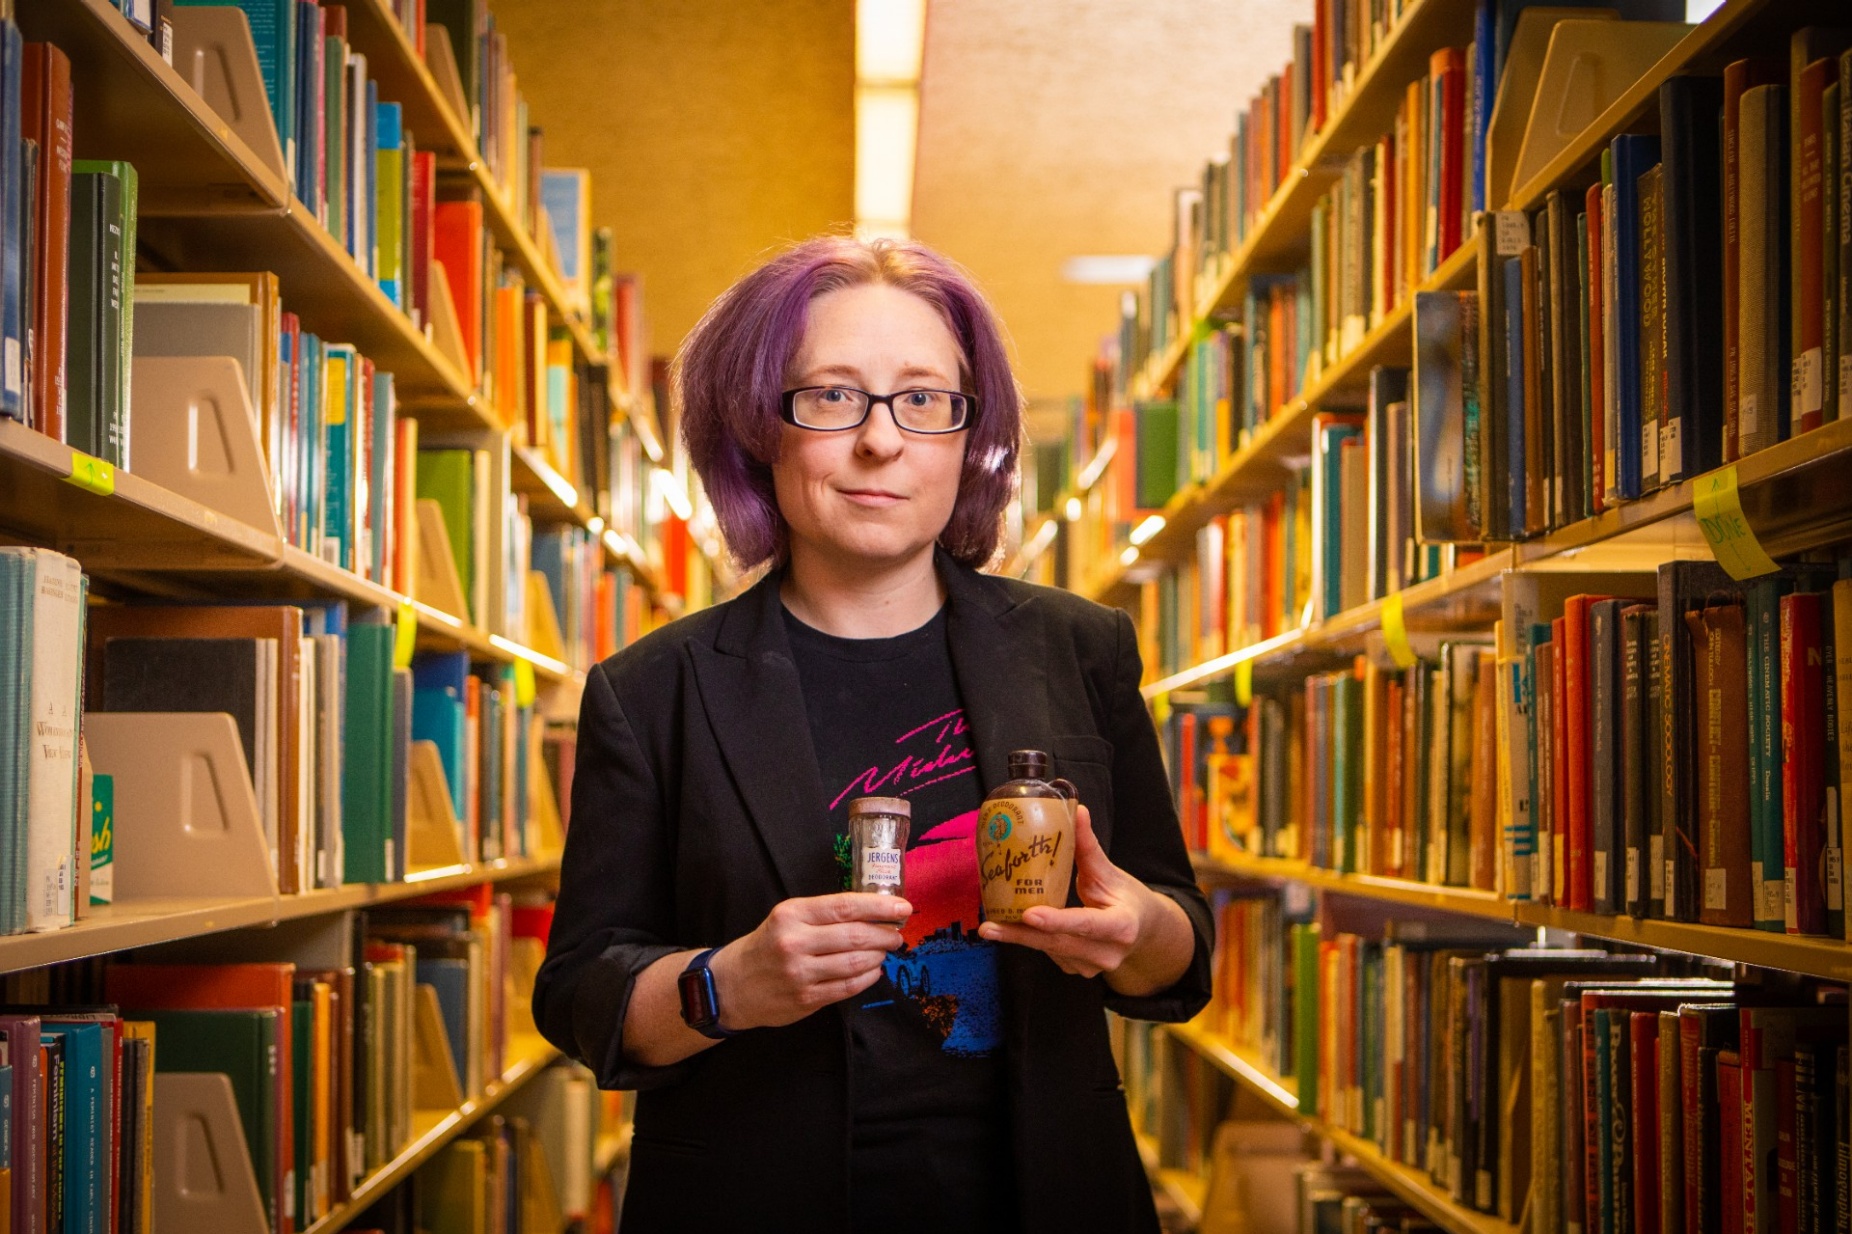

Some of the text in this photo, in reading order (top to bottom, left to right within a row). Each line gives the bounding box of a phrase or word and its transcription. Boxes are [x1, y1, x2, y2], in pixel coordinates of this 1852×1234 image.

[1643, 196, 1652, 328] HOLLYWOOD
[1663, 634, 1673, 797] CINEMATIC SOCIOLOGY
[993, 800, 1025, 825] DEODORANT
[867, 852, 899, 864] JERGENS
[1016, 879, 1043, 887] FOR
[1610, 1024, 1622, 1100] Power
[1744, 1101, 1755, 1201] MENTAL
